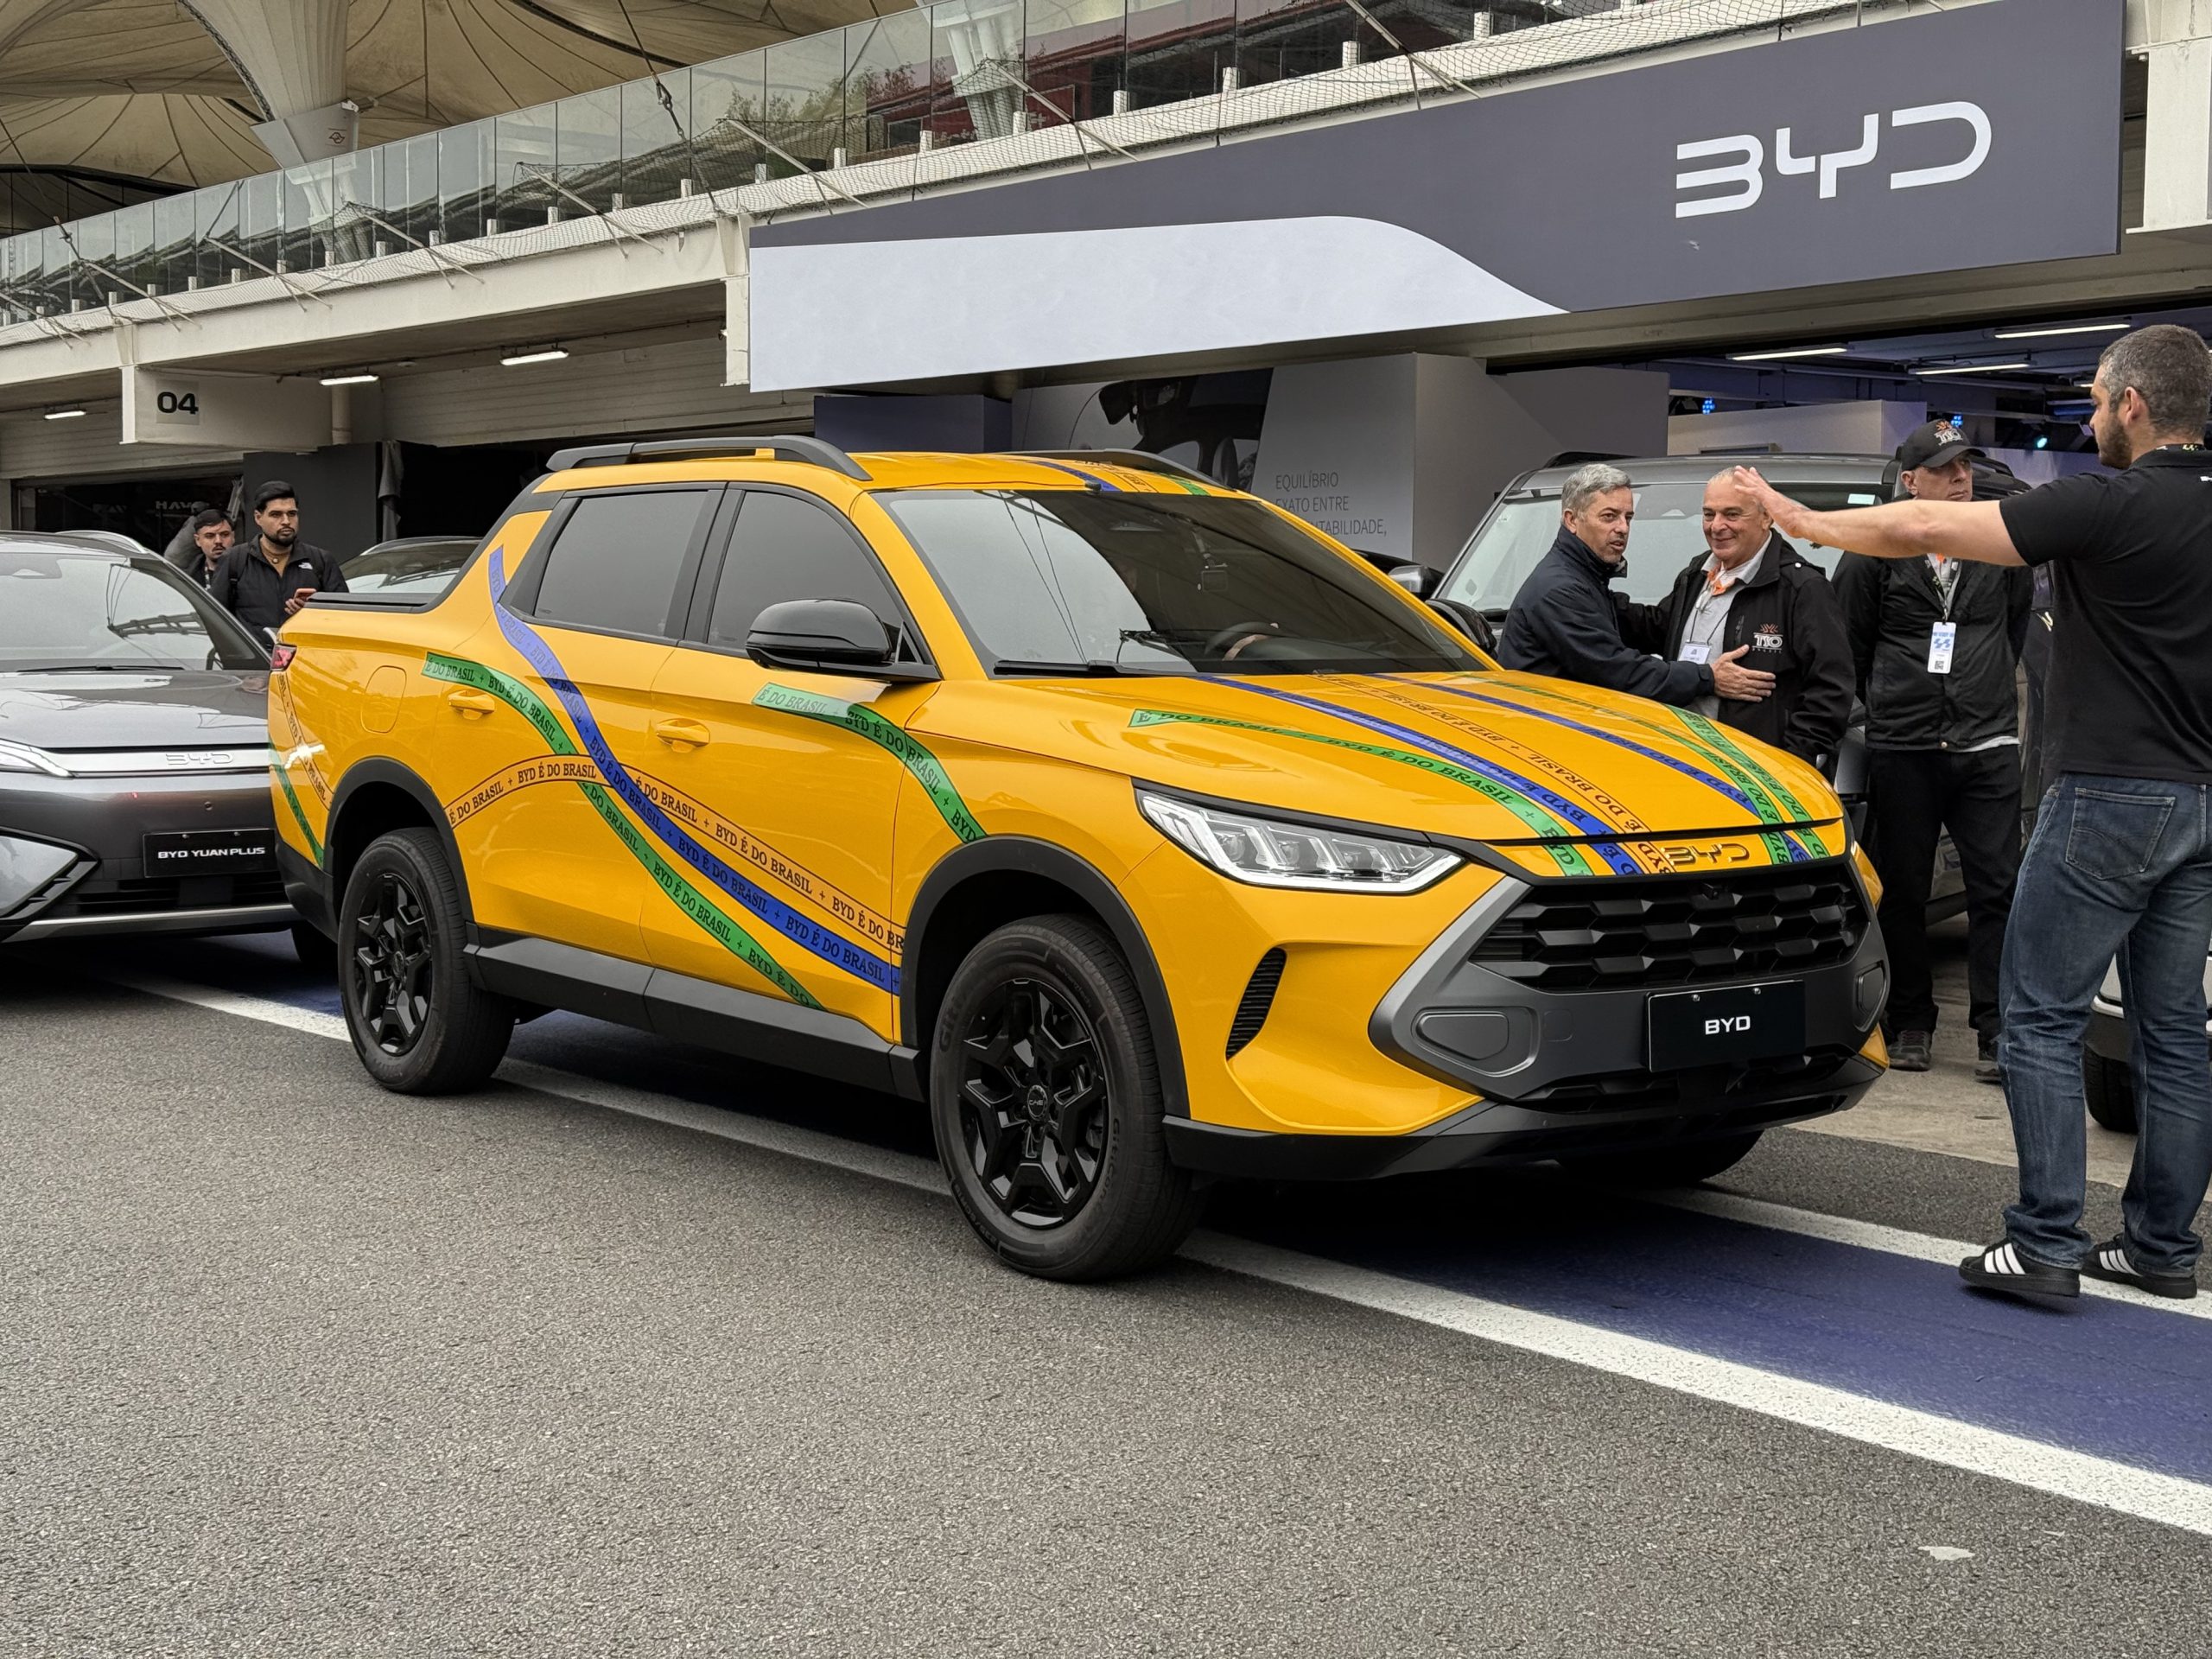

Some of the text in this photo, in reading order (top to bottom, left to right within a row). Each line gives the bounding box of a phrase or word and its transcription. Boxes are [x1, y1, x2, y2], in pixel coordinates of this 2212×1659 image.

[1675, 101, 1992, 219] BYD
[157, 391, 199, 415] 04
[1275, 470, 1339, 493] EQUILÍBRIO
[1313, 496, 1350, 512] ENTRE
[425, 658, 433, 672] É
[433, 662, 445, 675] DO
[445, 664, 475, 683] BRASIL
[488, 677, 505, 693] BYD
[506, 684, 516, 699] É
[513, 694, 529, 709] DO
[529, 704, 556, 741] BRASIL
[166, 753, 233, 766] BYD
[758, 687, 770, 702] É
[767, 690, 785, 705] DO
[785, 693, 827, 715] BRASIL
[845, 710, 869, 733] BYD
[874, 721, 882, 738] É
[886, 731, 905, 753] DO
[906, 747, 941, 796] BRASIL
[951, 809, 977, 842] BYD
[1137, 710, 1152, 723] É
[1199, 717, 1285, 734] BRASIL
[1400, 756, 1434, 768] DO
[1438, 766, 1514, 804] BRASIL
[1528, 753, 1596, 791] BRASIL
[449, 809, 456, 825] É
[457, 801, 471, 819] DO
[473, 780, 504, 810] BRASIL
[518, 767, 536, 784] BYD
[538, 761, 545, 778] É
[547, 763, 561, 778] DO
[563, 763, 597, 779] BRASIL
[1748, 787, 1771, 808] DO
[1541, 794, 1588, 823] BYD
[1595, 795, 1627, 816] DO
[1762, 810, 1780, 823] É
[1782, 794, 1808, 817] DO
[157, 847, 265, 860] BYD YUAN PLUS
[590, 736, 606, 765] BYD
[606, 760, 614, 776] É
[613, 771, 627, 792] DO
[628, 789, 662, 832] BRASIL
[678, 836, 700, 862] BYD
[702, 854, 710, 871] É
[712, 863, 728, 884] DO
[731, 877, 768, 914] BRASIL
[785, 915, 810, 940] BYD
[810, 928, 820, 948] É
[823, 936, 840, 958] DO
[842, 948, 886, 983] BRASIL
[645, 785, 658, 802] DO
[661, 791, 698, 823] BRASIL
[715, 823, 738, 847] BYD
[741, 836, 748, 855] É
[751, 845, 767, 865] DO
[771, 857, 813, 894] BRASIL
[832, 895, 855, 921] BYD
[858, 910, 866, 929] É
[868, 921, 884, 939] DO
[1660, 843, 1750, 866] BYD
[590, 787, 604, 808] DO
[606, 805, 639, 851] BRASIL
[653, 861, 673, 889] BYD
[673, 881, 683, 899] É
[681, 893, 696, 912] DO
[696, 905, 732, 943] BRASIL
[748, 948, 772, 976] BYD
[775, 971, 785, 987] É
[1705, 1015, 1751, 1035] BYD
